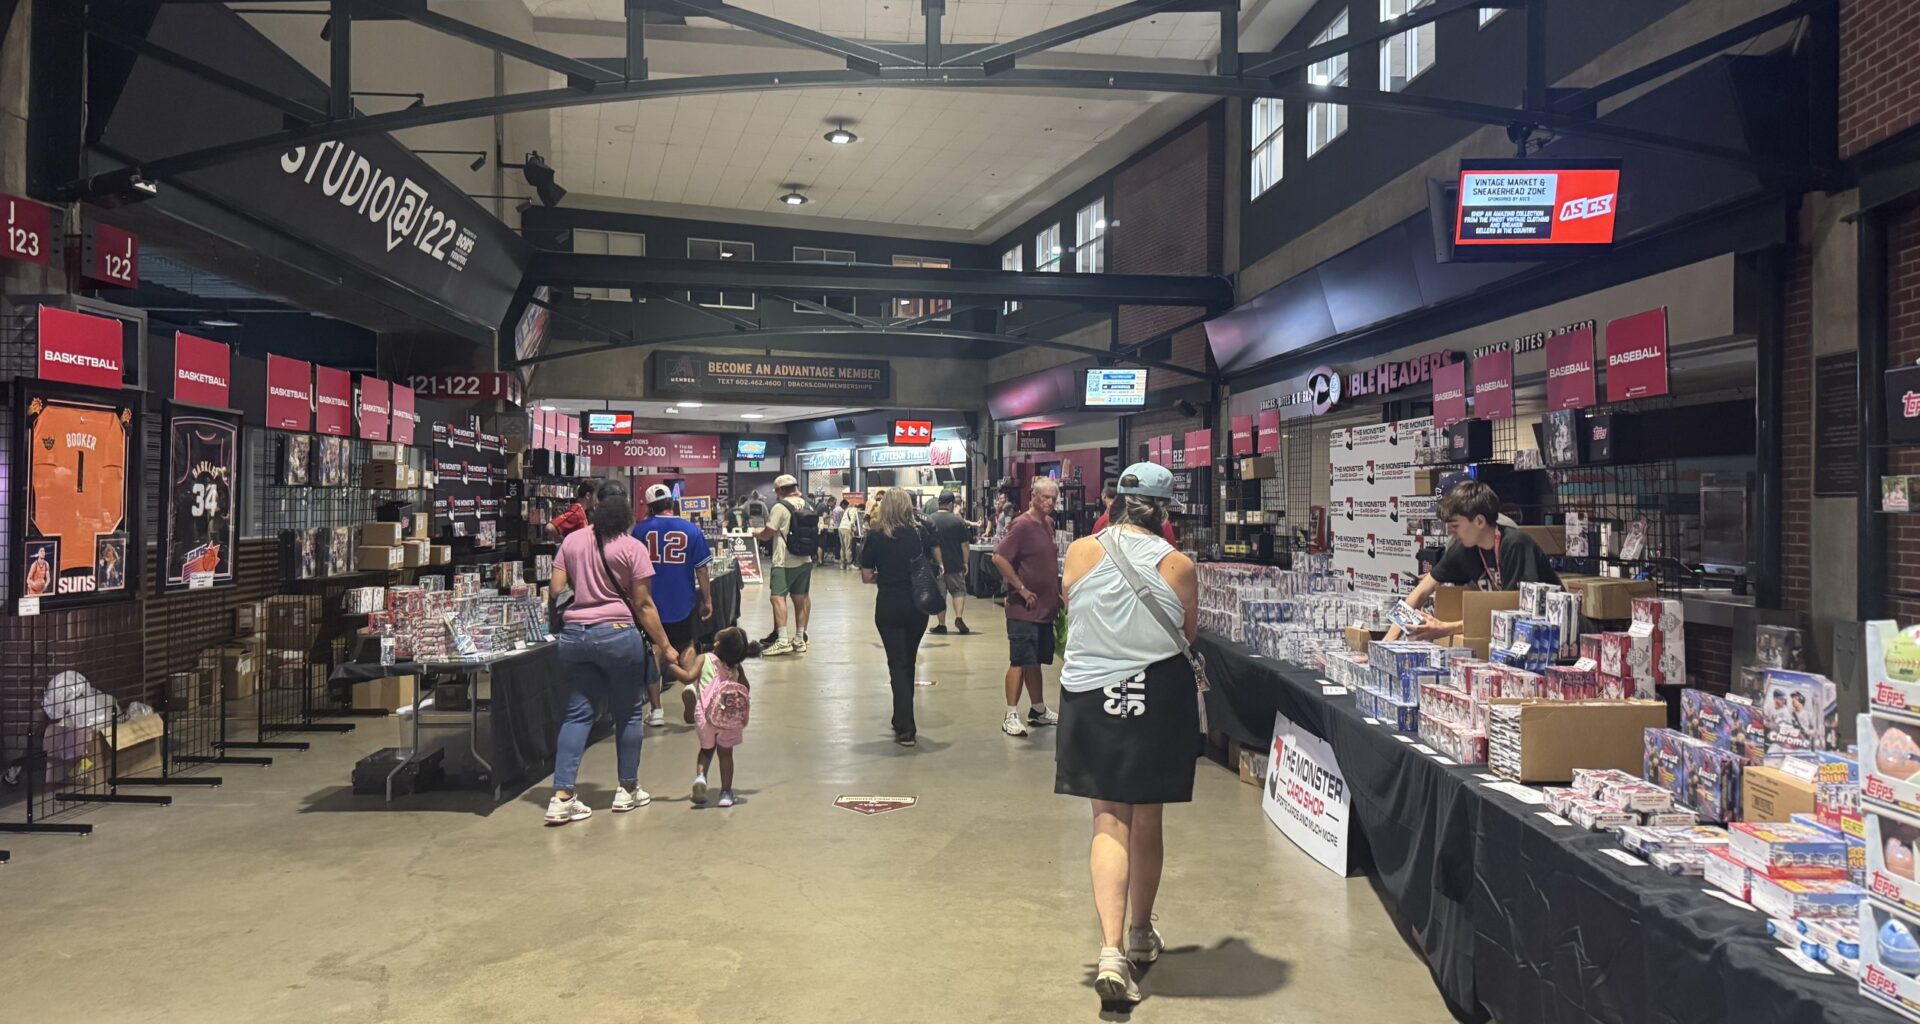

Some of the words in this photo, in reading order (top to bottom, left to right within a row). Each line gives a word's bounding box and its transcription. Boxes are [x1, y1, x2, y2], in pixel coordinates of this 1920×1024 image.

[1472, 187, 1525, 196] SNEAKERHEAD
[1527, 187, 1546, 196] ZONE
[1475, 178, 1504, 187] VINTAGE
[1507, 178, 1537, 187] MARKET
[8, 201, 15, 225] J
[8, 226, 39, 256] 123
[125, 237, 132, 258] J
[105, 254, 131, 281] 122
[1515, 332, 1542, 353] BITES
[44, 349, 118, 371] BASKETBALL
[1609, 345, 1661, 367] BASEBALL
[178, 368, 227, 387] BASKETBALL
[708, 361, 752, 374] BECOME
[755, 363, 771, 375] AN
[774, 364, 835, 379] ADVANTAGE
[838, 367, 880, 380] MEMBER
[1550, 361, 1590, 378] BASEBALL
[270, 386, 309, 401] BASKETBALL
[407, 376, 480, 396] 121-122
[492, 376, 500, 396] J
[1476, 377, 1508, 394] BASEBALL
[319, 395, 349, 408] BASKETBALL
[1434, 389, 1462, 402] BASEBALL
[363, 403, 388, 415] BASKETBALL
[1363, 426, 1386, 435] MONSTER
[1410, 418, 1434, 429] MONSTE
[66, 433, 96, 450] BOOKER
[624, 446, 667, 457] 200-300
[78, 451, 84, 493] 1
[191, 483, 218, 517] 34
[684, 500, 698, 509] SEC
[645, 530, 688, 564] 12
[1385, 539, 1411, 547] MONSTER
[1363, 573, 1387, 583] MONSTER
[1282, 745, 1295, 772] THE
[1294, 757, 1343, 803] MONSTER
[1287, 778, 1304, 805] CARD
[1303, 791, 1325, 817] SHOP
[1299, 813, 1309, 827] AND
[1308, 820, 1322, 836] MUCH
[1322, 829, 1338, 847] MORE
